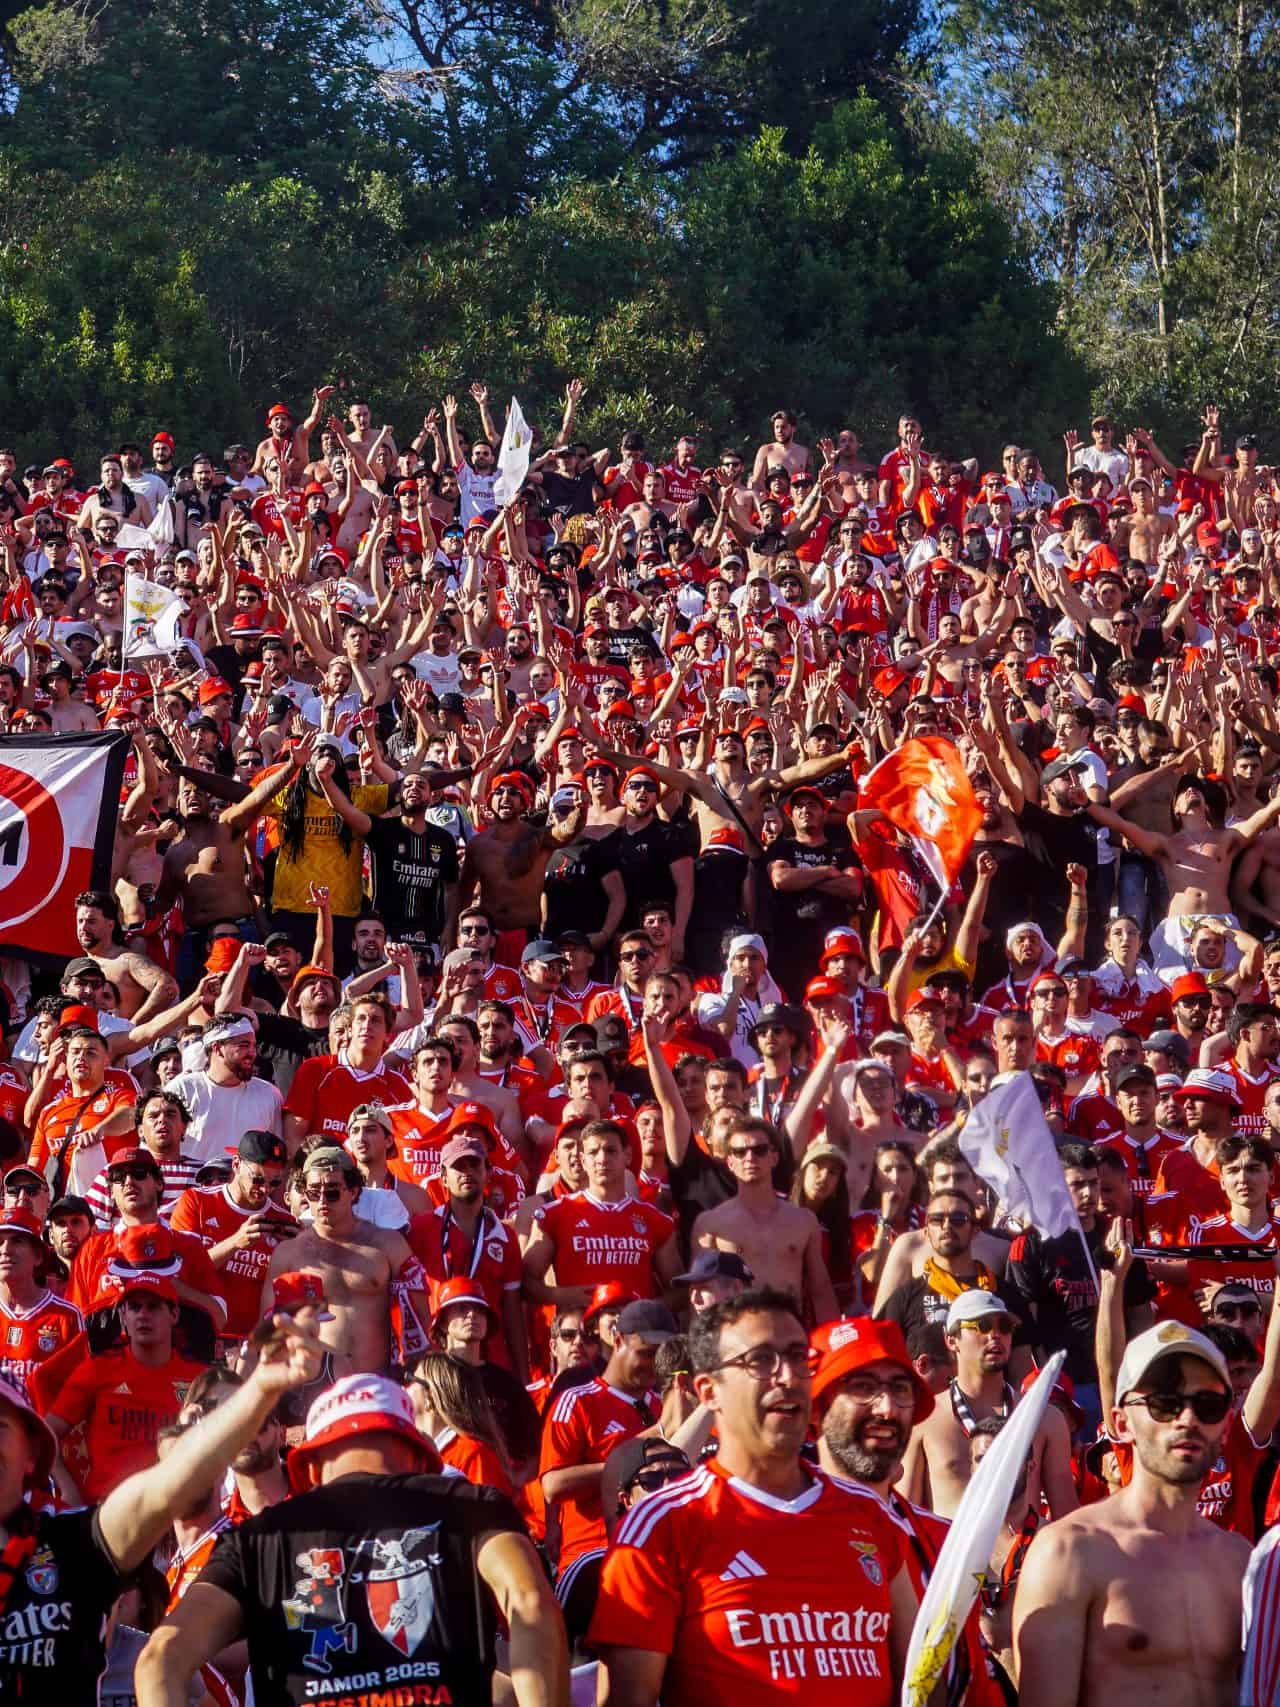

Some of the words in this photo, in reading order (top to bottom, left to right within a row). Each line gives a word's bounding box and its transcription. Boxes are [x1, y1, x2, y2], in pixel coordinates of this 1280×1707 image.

[572, 1235, 650, 1252] Emirates
[586, 1252, 604, 1265] FLY
[606, 1251, 641, 1265] BETTER
[724, 1603, 891, 1648] Emirates
[304, 1671, 381, 1697] JAMOR
[385, 1661, 440, 1683] 2025
[770, 1647, 807, 1681] FLY
[816, 1645, 882, 1679] BETTER
